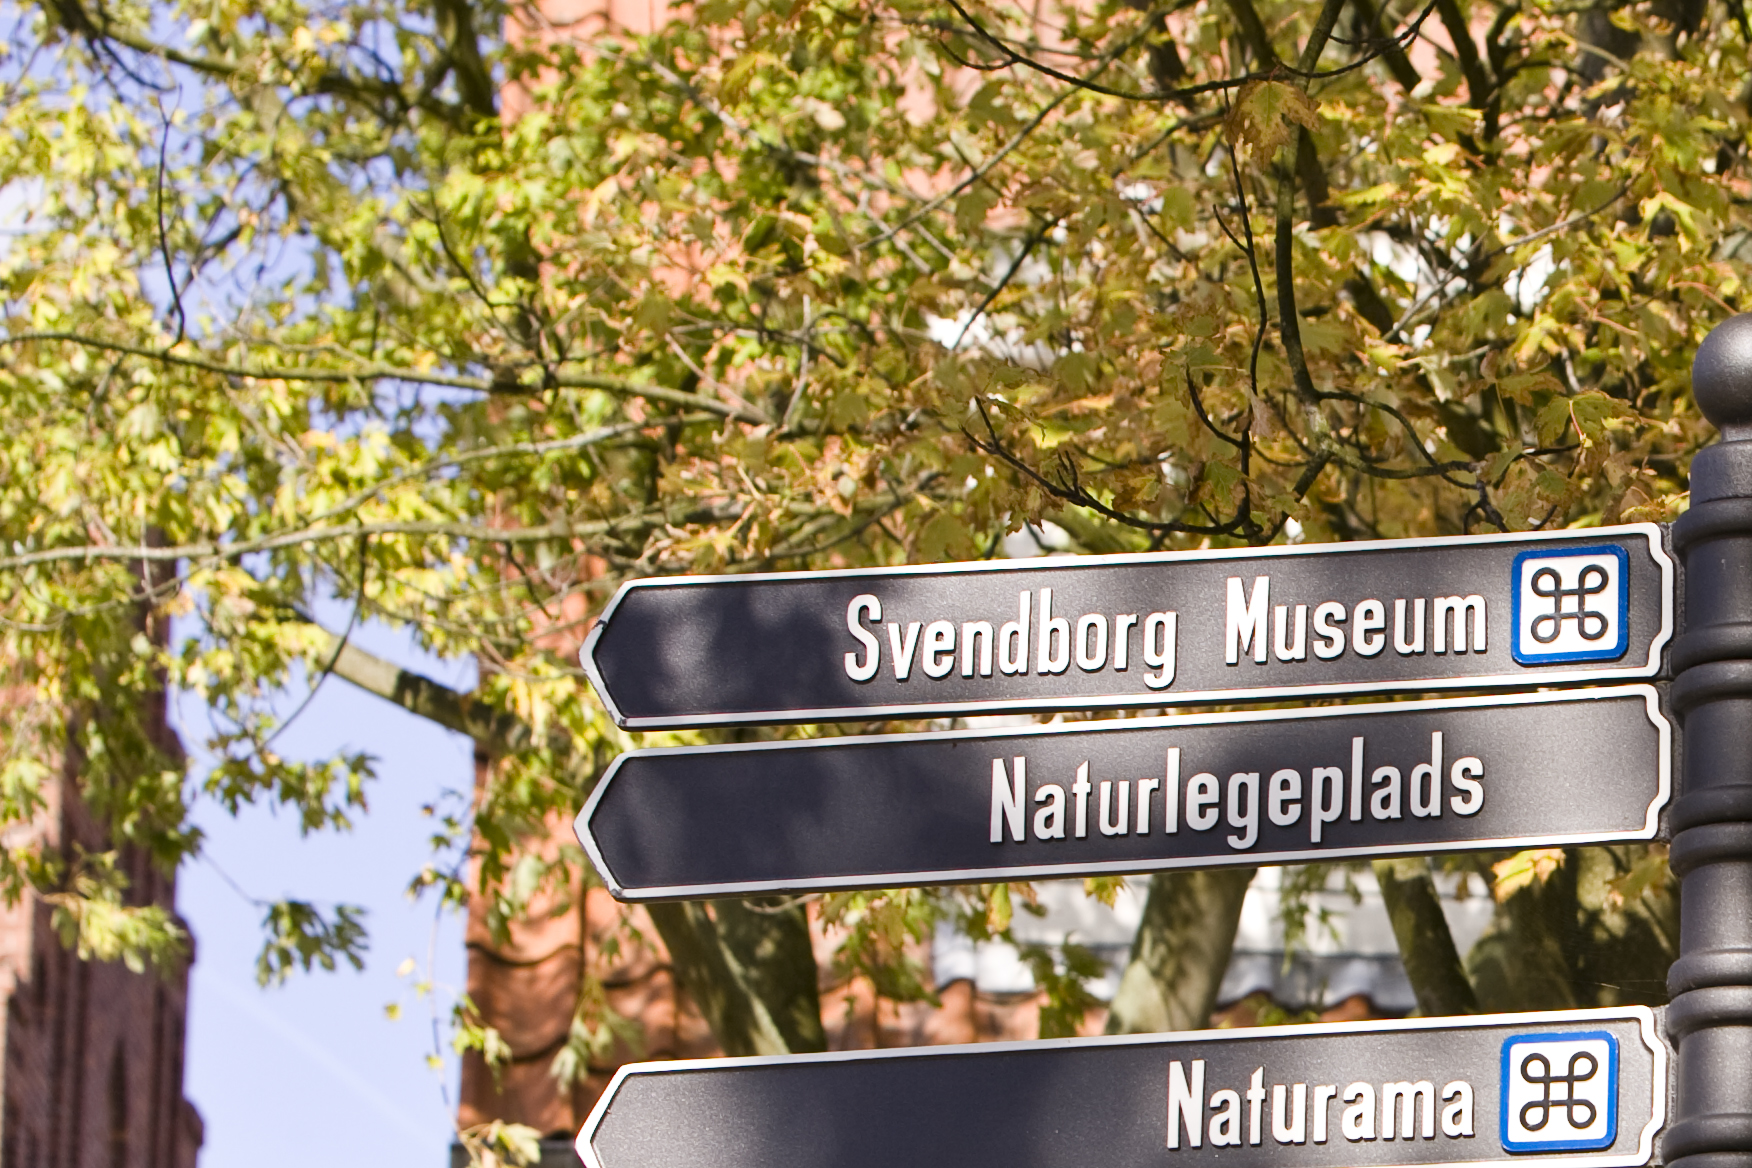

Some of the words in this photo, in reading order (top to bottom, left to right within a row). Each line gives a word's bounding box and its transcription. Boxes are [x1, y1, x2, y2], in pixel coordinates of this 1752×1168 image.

[843, 586, 1179, 690] Svendborg
[1225, 574, 1488, 667] Museum
[989, 730, 1486, 850] Naturlegeplads
[1166, 1058, 1476, 1150] Naturama
